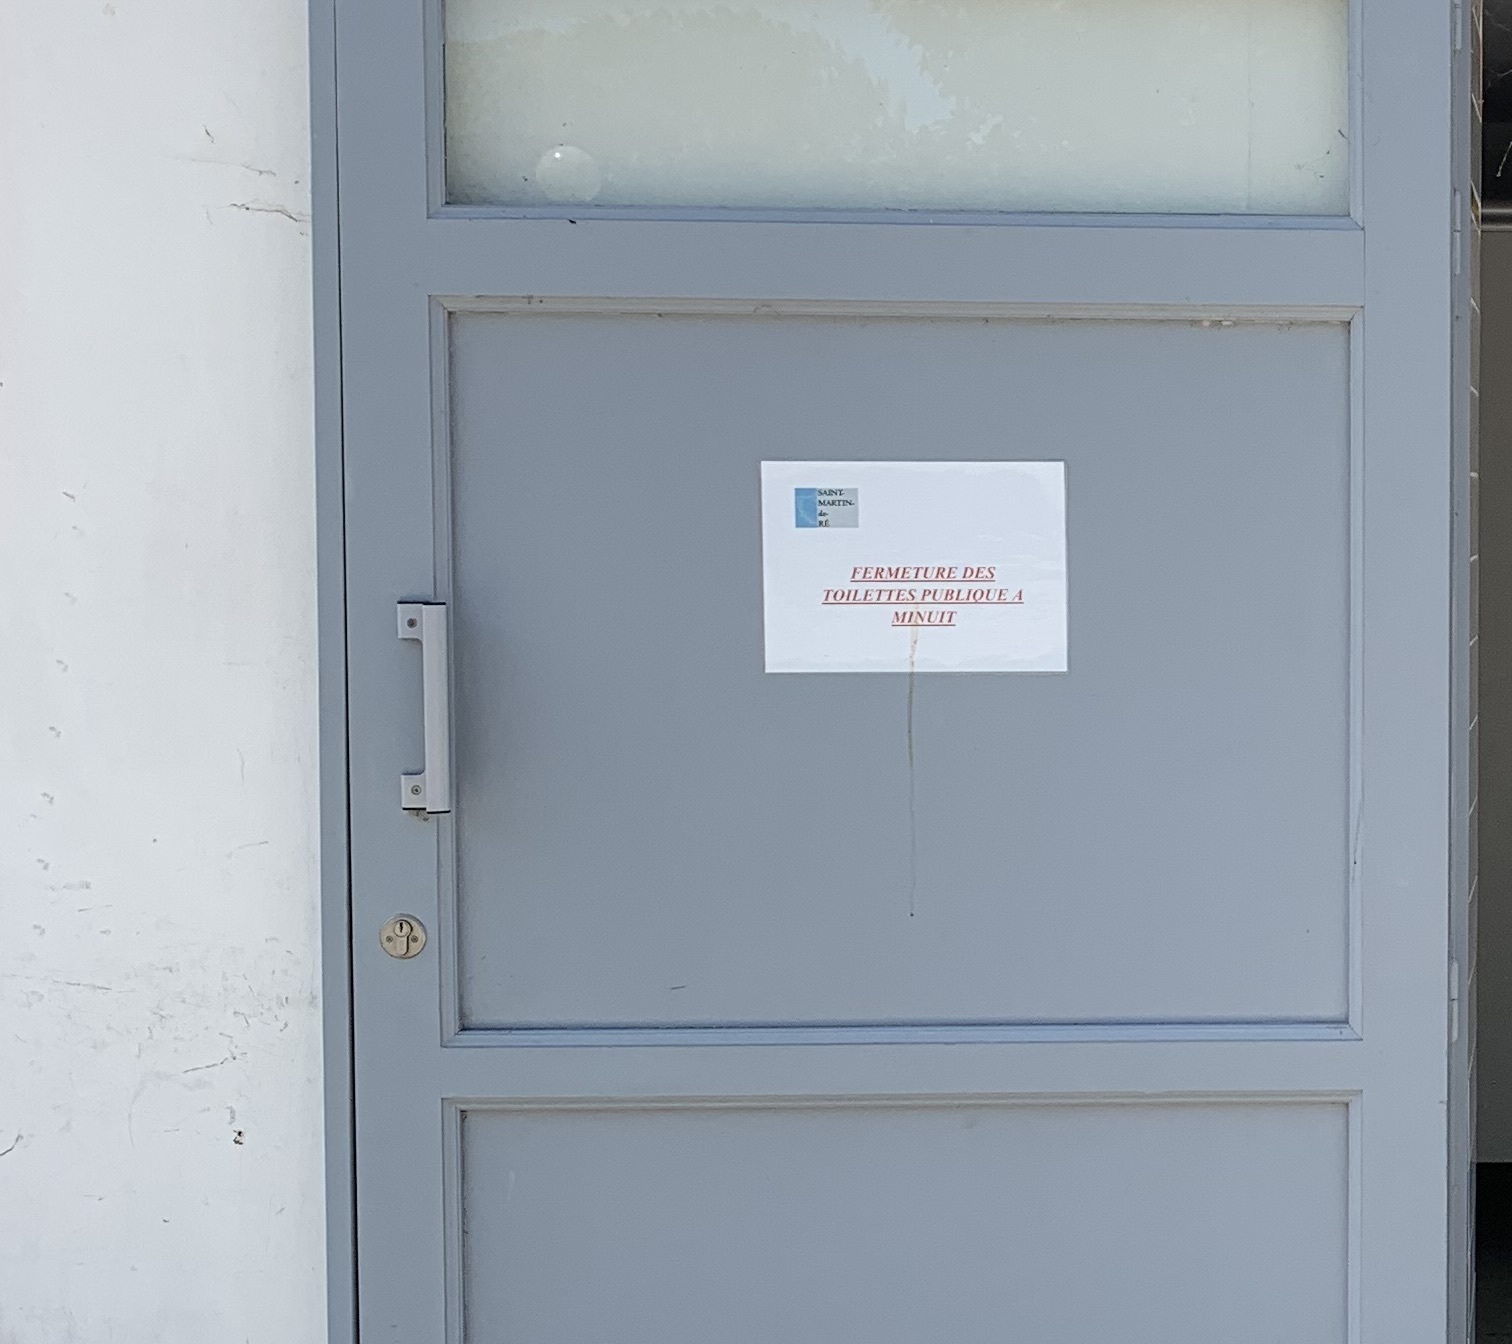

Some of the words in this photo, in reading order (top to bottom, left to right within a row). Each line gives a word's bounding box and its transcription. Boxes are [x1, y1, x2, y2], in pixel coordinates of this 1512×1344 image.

[850, 566, 957, 580] FERMETURE
[962, 566, 996, 580] DES
[822, 588, 916, 602] TOILETTES
[920, 588, 1008, 603] PUBLIQUE
[1012, 589, 1024, 602] A
[891, 610, 957, 625] MINUIT
